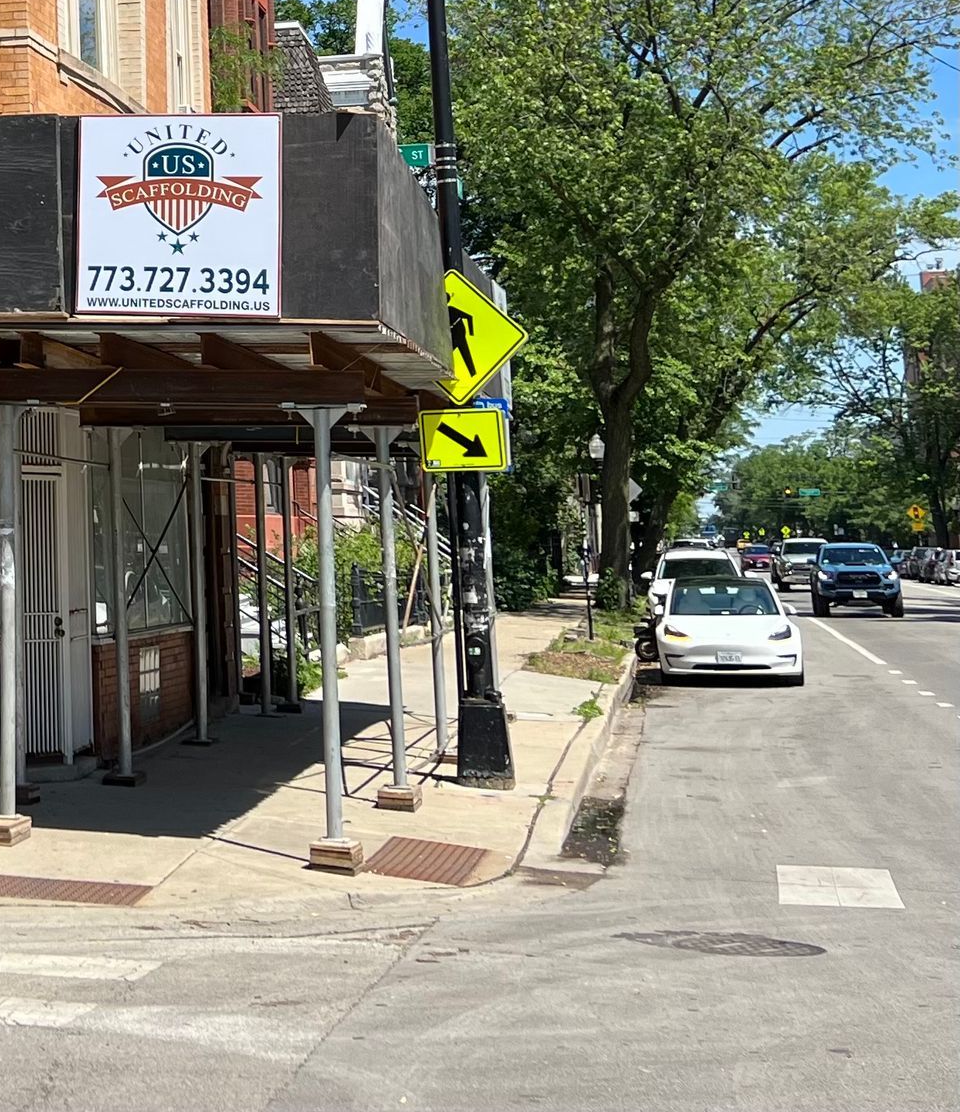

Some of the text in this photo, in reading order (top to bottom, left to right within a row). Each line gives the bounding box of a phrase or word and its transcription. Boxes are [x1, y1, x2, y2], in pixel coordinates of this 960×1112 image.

[126, 123, 228, 156] UNITED
[161, 154, 196, 175] US
[411, 150, 424, 160] ST
[110, 182, 247, 208] SCAFFOLDING
[87, 265, 270, 295] 773.727.3394
[86, 297, 271, 312] WWW.UNITEDSCAFFOLDING.US
